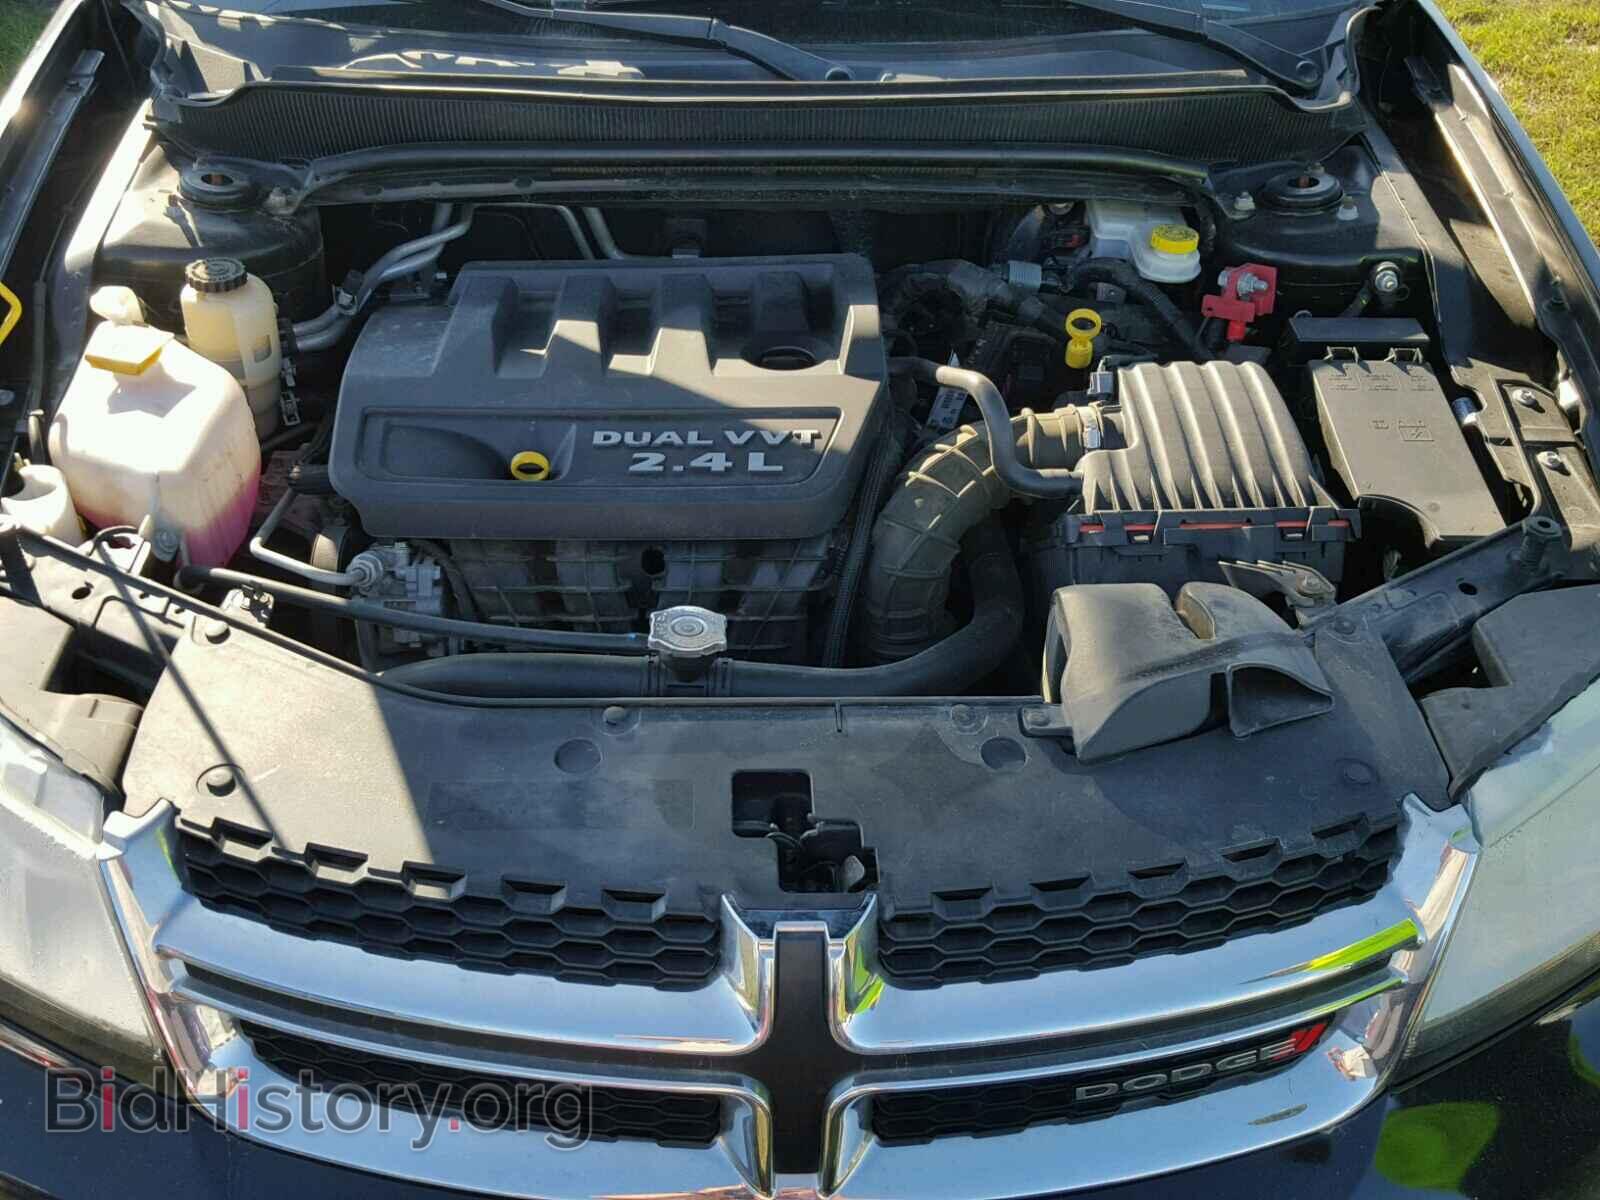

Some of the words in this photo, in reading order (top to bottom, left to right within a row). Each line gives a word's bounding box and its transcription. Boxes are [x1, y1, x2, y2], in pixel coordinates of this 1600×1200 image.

[592, 430, 714, 446] DUAL
[724, 429, 821, 447] VVT
[1075, 1038, 1297, 1101] DODGE
